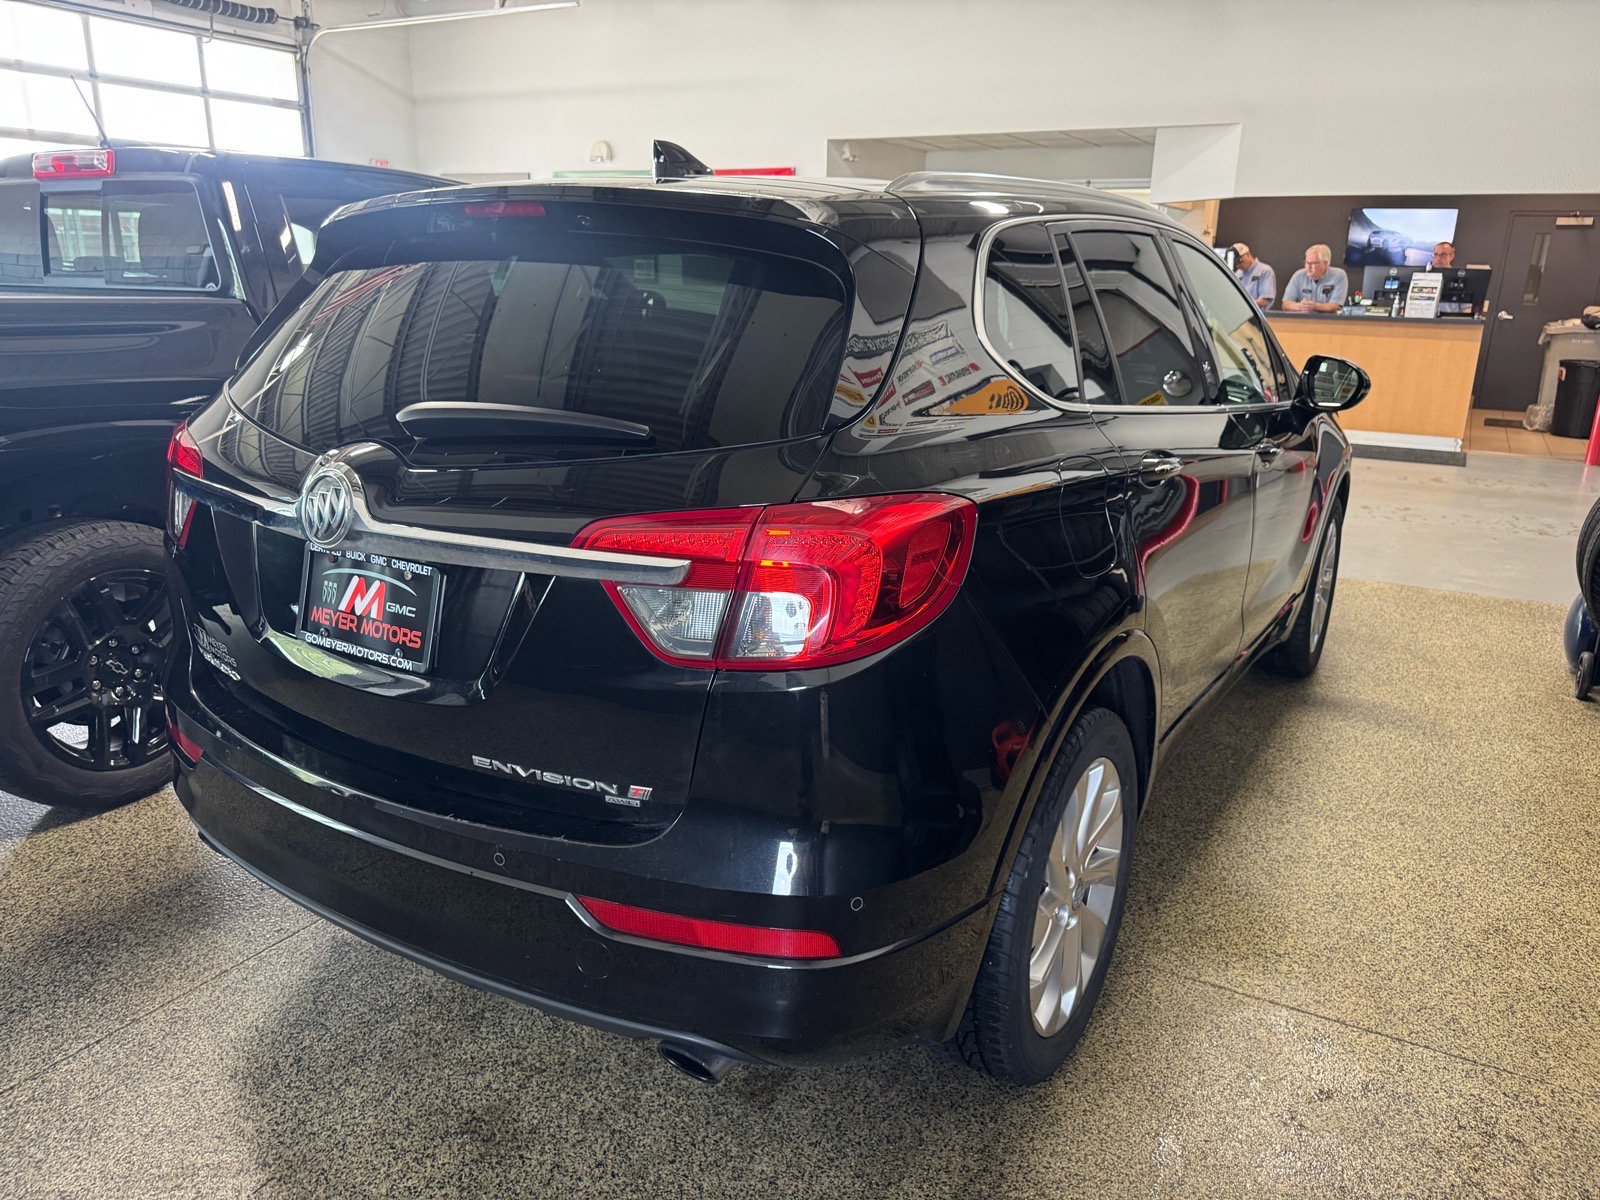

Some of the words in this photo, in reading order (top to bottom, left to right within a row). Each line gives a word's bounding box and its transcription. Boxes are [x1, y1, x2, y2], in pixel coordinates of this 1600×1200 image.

[345, 550, 367, 562] BUICK
[370, 554, 387, 566] GMC
[391, 559, 432, 576] CHEVROLET
[385, 603, 417, 618] GMC
[311, 605, 358, 633] MEYER
[360, 619, 422, 649] MOTORS
[207, 635, 228, 654] MEYER
[209, 645, 238, 667] MOTORS
[305, 633, 413, 671] GOMEYERMOTORS.COM
[471, 755, 619, 796] ENVISION
